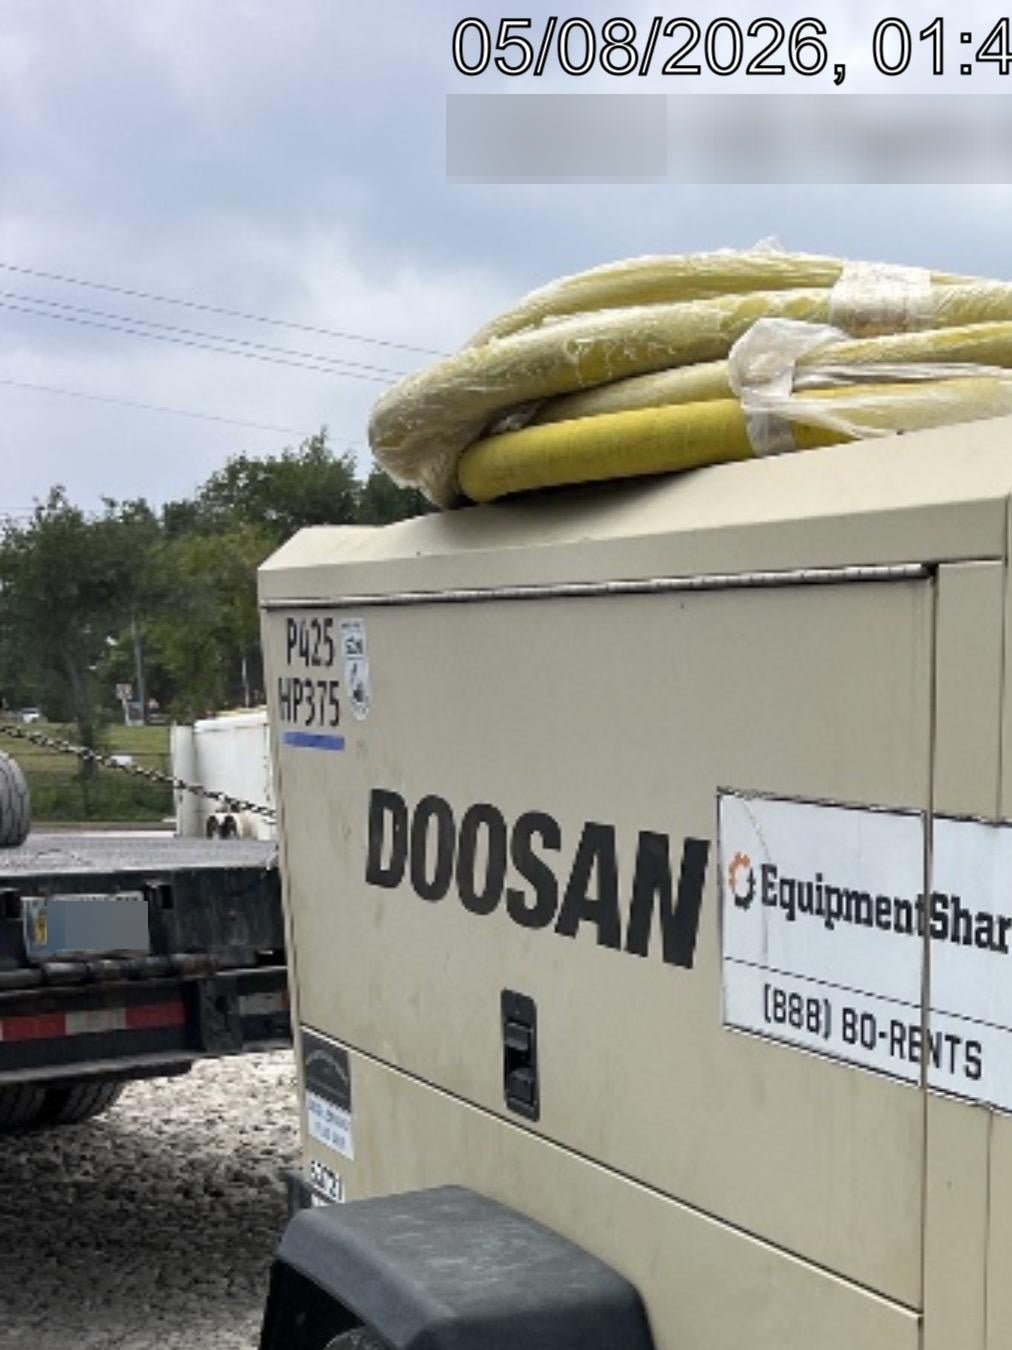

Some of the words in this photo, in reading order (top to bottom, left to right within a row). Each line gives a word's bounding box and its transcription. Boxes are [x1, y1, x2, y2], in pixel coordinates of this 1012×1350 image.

[286, 617, 335, 668] P425
[278, 676, 340, 727] HP375
[365, 788, 711, 969] DOOSAN
[763, 983, 832, 1040] (888)
